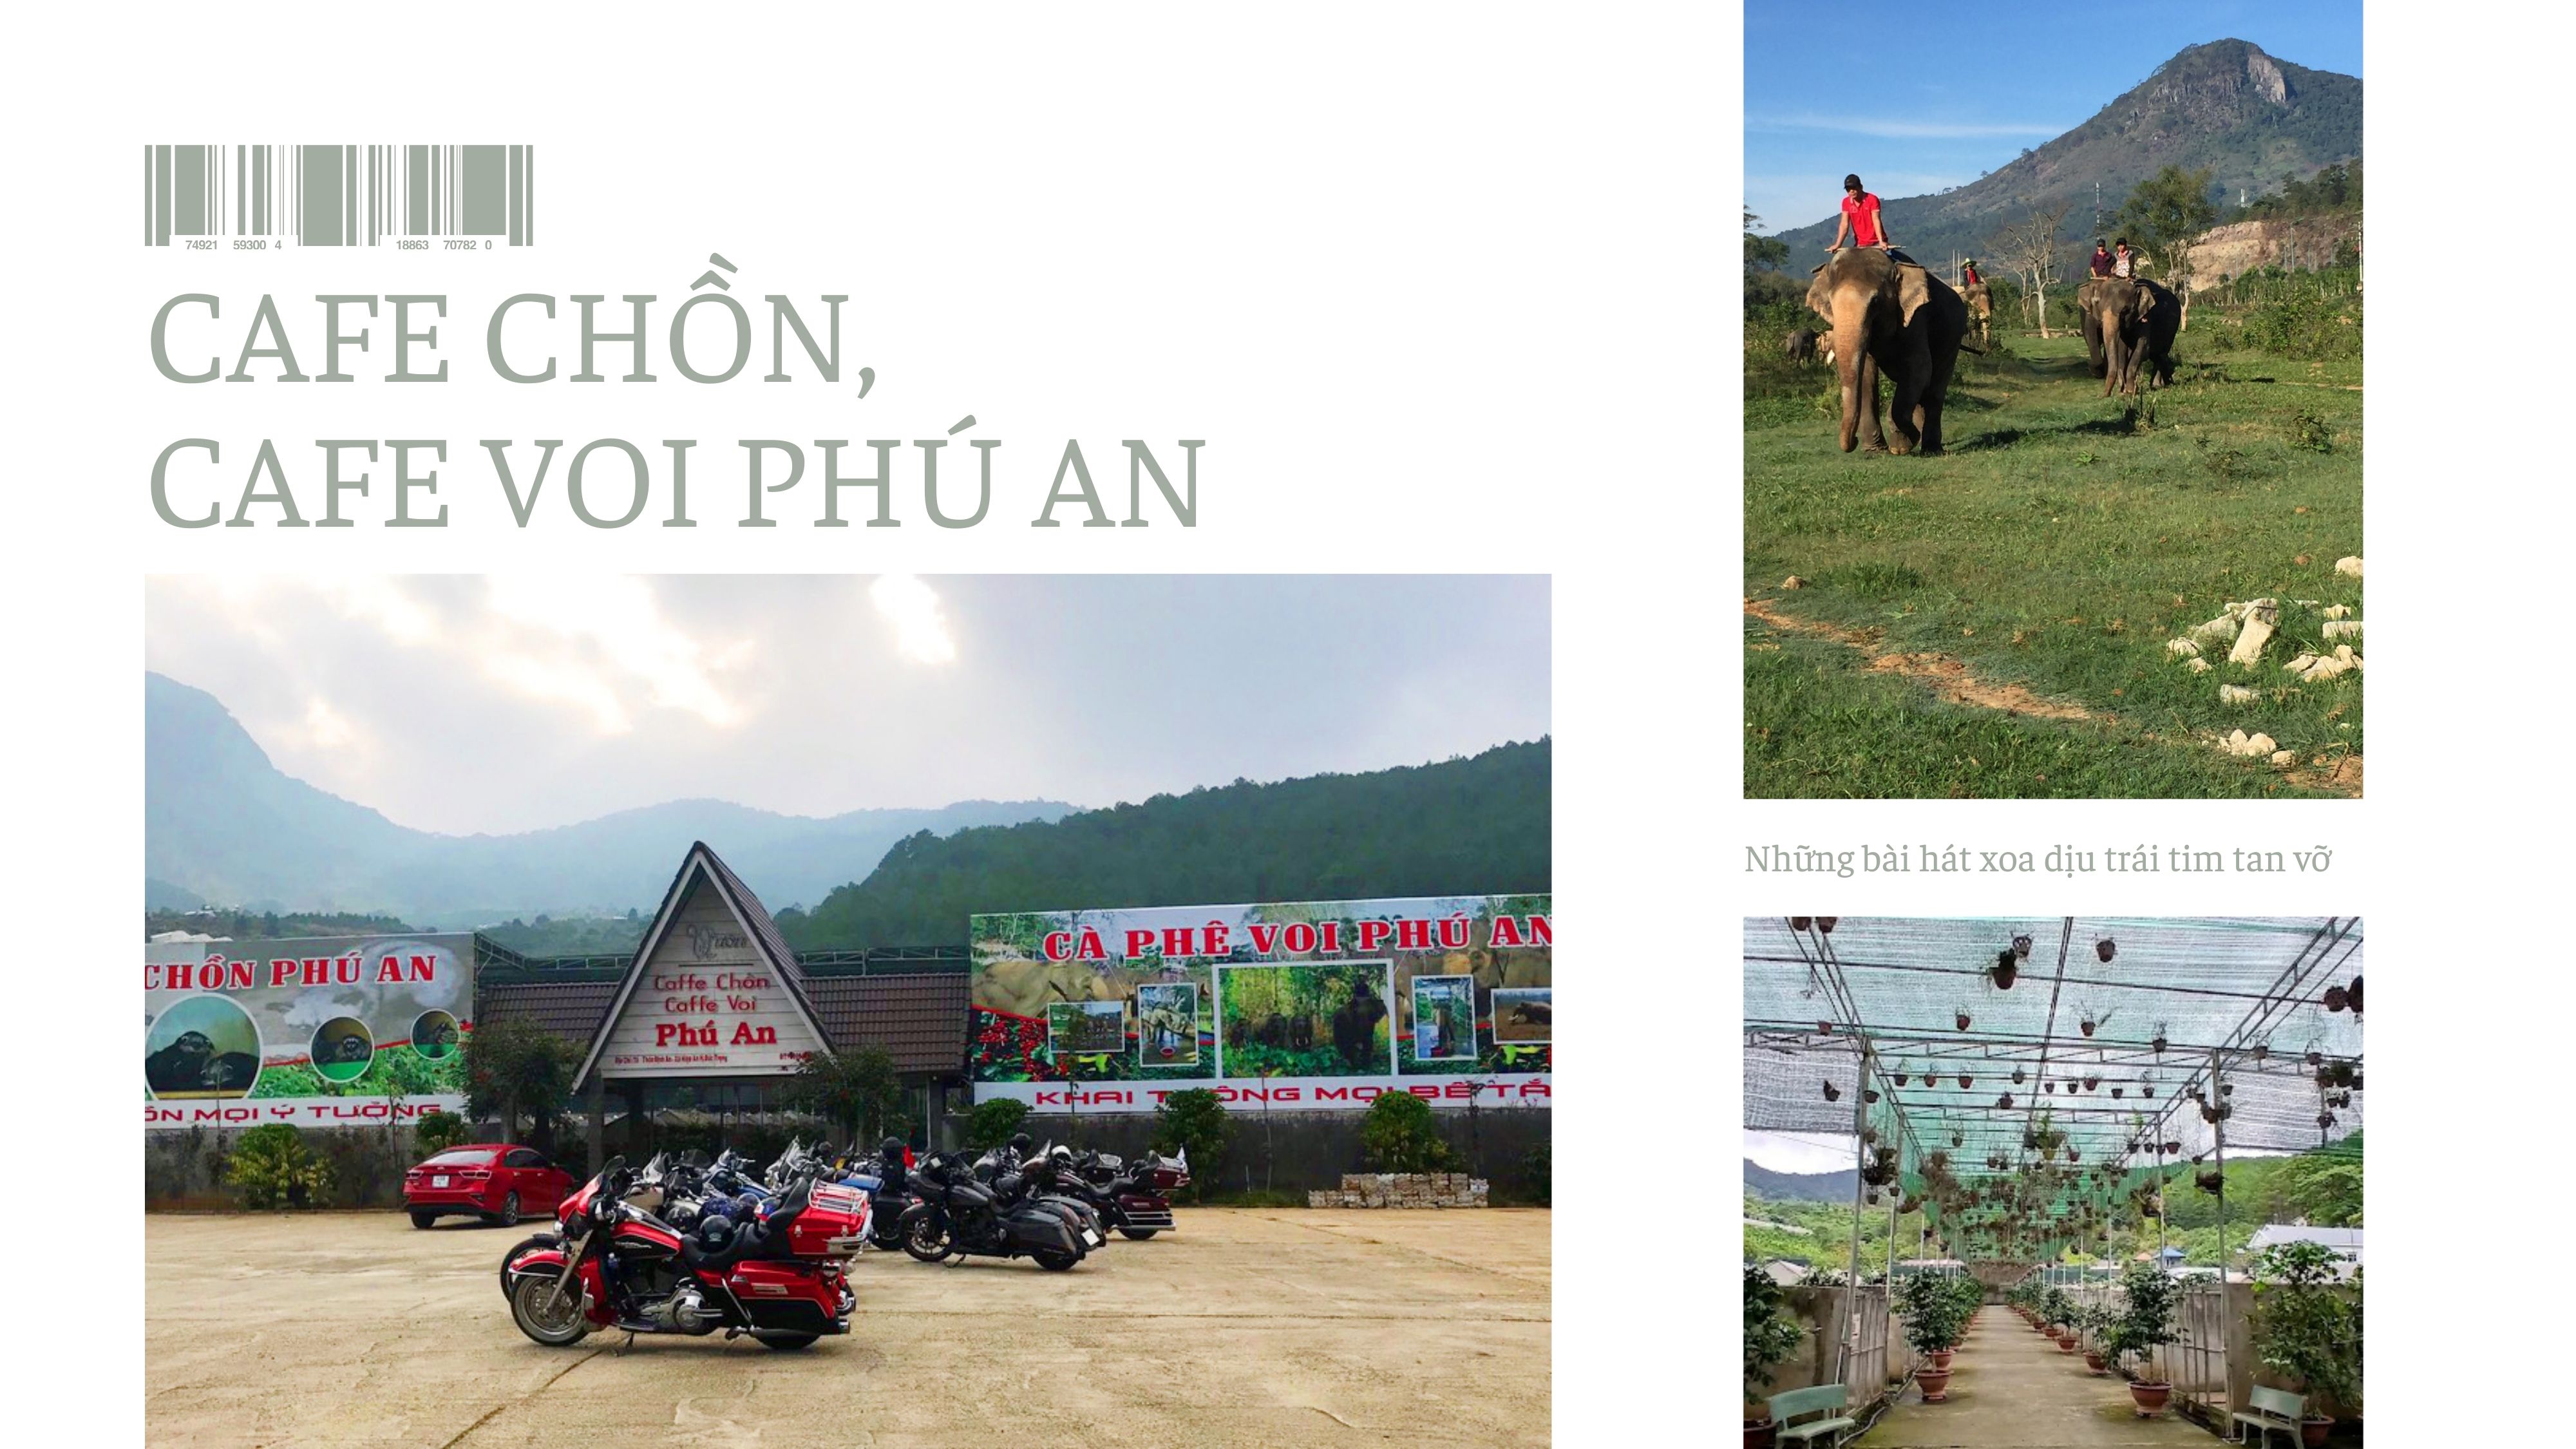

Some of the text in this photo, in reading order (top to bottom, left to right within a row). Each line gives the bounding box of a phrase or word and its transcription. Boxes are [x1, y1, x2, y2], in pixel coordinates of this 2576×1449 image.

[1043, 911, 1552, 961] CÀ PHÊ VOI PHÚ AN
[269, 950, 362, 987] PHÚ
[376, 955, 437, 983] AN
[655, 974, 707, 990] Caffe
[665, 996, 757, 1013] Caffe Voi
[656, 1019, 777, 1048] Phú An
[1036, 1091, 1133, 1105] KHAI
[1148, 1086, 1300, 1103] TÔNG
[195, 1108, 258, 1123] MỌI
[271, 1104, 295, 1119] Ý
